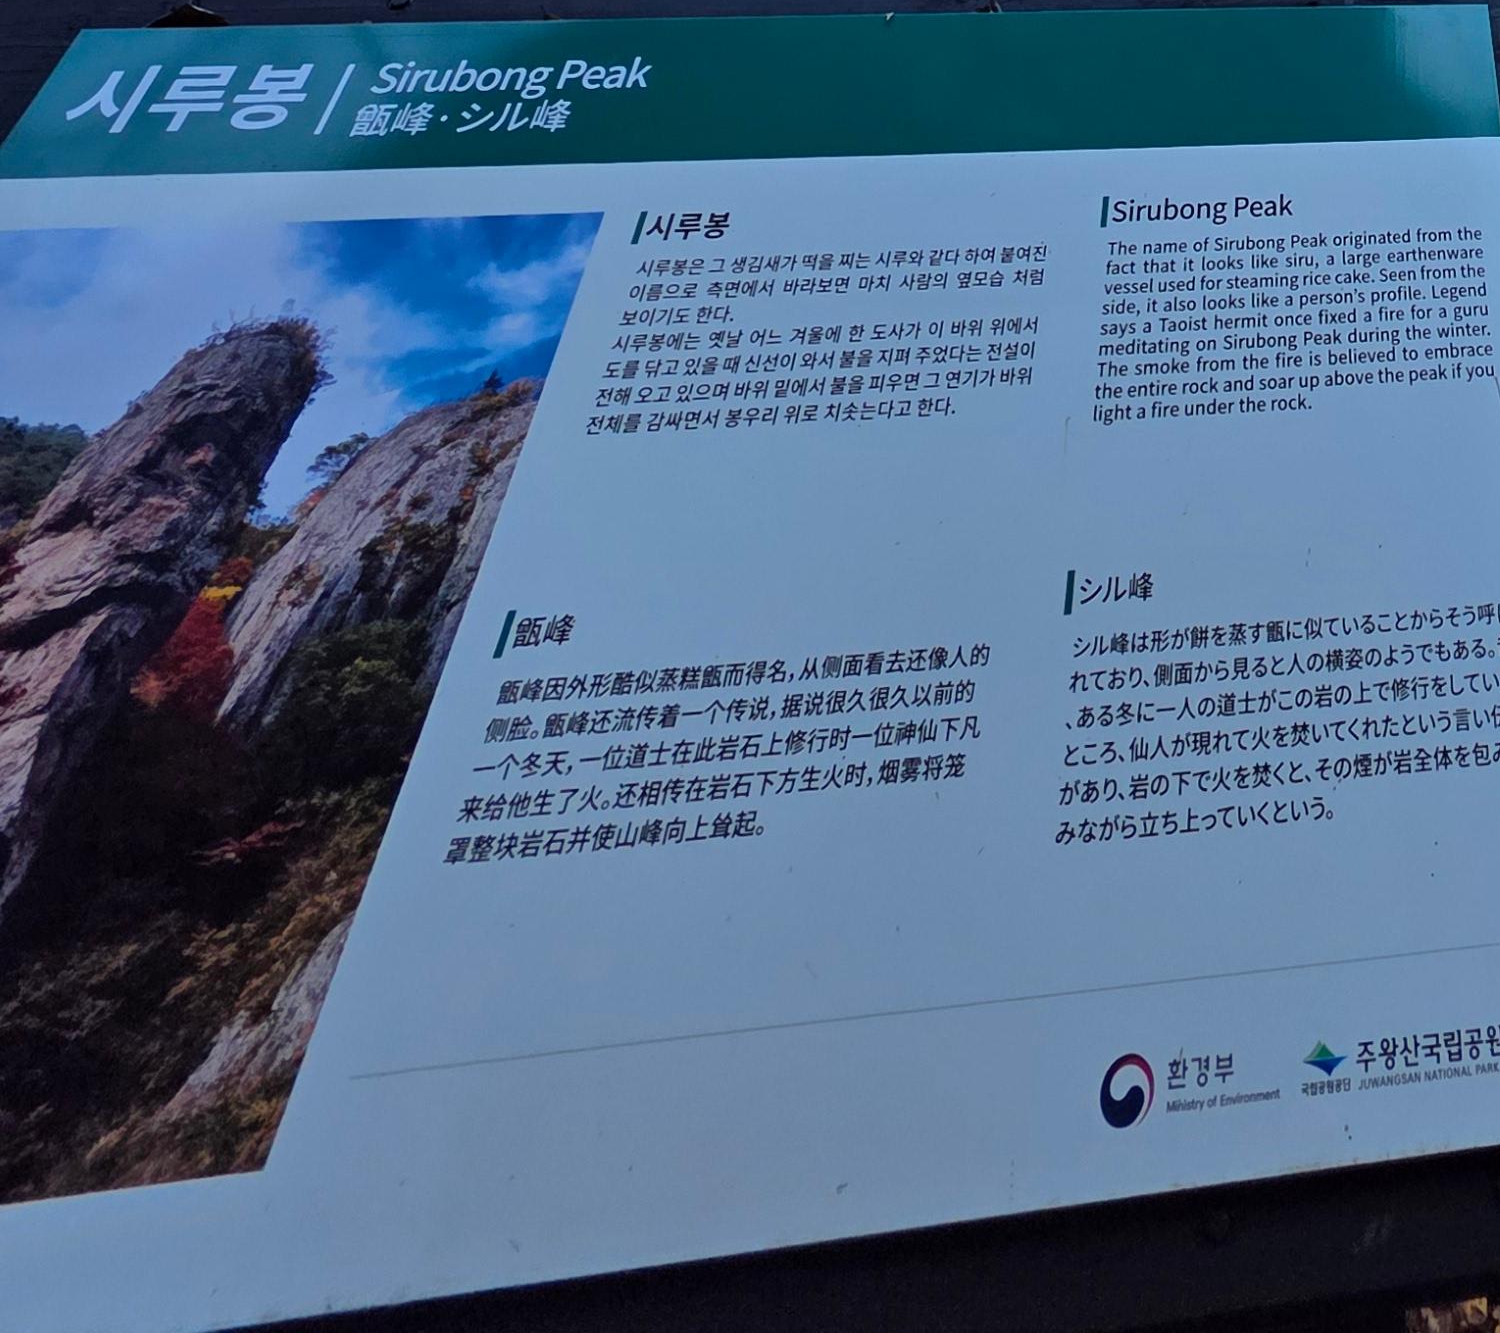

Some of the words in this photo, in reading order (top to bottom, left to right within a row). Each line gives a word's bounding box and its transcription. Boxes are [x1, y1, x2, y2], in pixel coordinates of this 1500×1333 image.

[370, 59, 554, 99] Sirubong
[556, 56, 652, 90] Peak
[65, 63, 314, 133] 시루봉
[646, 211, 731, 241] 시루봉
[1112, 197, 1228, 225] Sirubong
[1234, 193, 1292, 218] Peak
[1108, 241, 1137, 255] The
[1143, 242, 1187, 254] name
[1193, 237, 1210, 252] of
[1214, 235, 1285, 253] Sirubong
[1291, 233, 1327, 249] Peak
[1333, 229, 1410, 250] originated
[1416, 228, 1452, 242] from
[1458, 227, 1481, 241] the
[636, 259, 704, 277] 시루봉은
[708, 259, 725, 273] 그
[731, 255, 798, 274] 생김새가
[802, 254, 834, 271] 떡을
[838, 253, 870, 269] 찌는
[875, 250, 924, 268] 시루와
[929, 249, 960, 266] 같다
[965, 247, 996, 265] 하여
[1000, 242, 1047, 263] 붙여진
[1106, 260, 1136, 275] fact
[1144, 258, 1176, 273] that
[1184, 257, 1194, 272] it
[1202, 255, 1244, 271] looks
[1252, 254, 1278, 269] like
[1286, 252, 1319, 269] siru,
[1326, 255, 1334, 265] a
[1342, 250, 1380, 268] large
[1387, 247, 1483, 263] earthenware
[630, 283, 698, 302] 이름으로
[706, 279, 775, 299] 측면에서
[783, 276, 850, 296] 바라보면
[858, 274, 891, 292] 마치
[899, 271, 948, 291] 사람의
[957, 270, 1004, 289] 옆모습
[1012, 268, 1044, 286] 처럼
[1105, 277, 1153, 295] vessel
[1158, 276, 1195, 293] used
[1200, 275, 1223, 291] for
[1226, 272, 1299, 291] steaming
[1303, 271, 1331, 286] rice
[1335, 269, 1375, 284] cake.
[1379, 268, 1416, 282] Seen
[1420, 265, 1456, 280] from
[1460, 263, 1485, 278] the
[619, 307, 691, 327] 보이기도
[696, 305, 734, 324] 한다.
[1102, 299, 1140, 317] side,
[1147, 298, 1158, 313] it
[1164, 297, 1196, 312] also
[1203, 294, 1245, 311] looks
[1252, 292, 1279, 308] like
[1284, 295, 1293, 307] a
[1300, 288, 1365, 310] person’s
[1371, 285, 1426, 306] profile.
[1432, 282, 1486, 302] Legend
[612, 332, 701, 353] 시루봉에는
[708, 329, 744, 349] 옛날
[750, 329, 782, 347] 어느
[789, 325, 842, 345] 겨울에
[849, 325, 865, 343] 한
[870, 321, 922, 341] 도사가
[929, 321, 944, 339] 이
[950, 319, 983, 337] 바위
[990, 317, 1038, 336] 위에서
[1099, 337, 1190, 357] meditating
[1196, 339, 1216, 351] on
[1223, 332, 1298, 351] Sirubong
[1304, 329, 1342, 346] Peak
[1348, 327, 1400, 345] during
[1405, 325, 1431, 340] the
[1437, 322, 1490, 338] winter.
[602, 360, 640, 379] 도를
[645, 359, 679, 379] 닦고
[682, 357, 718, 376] 있을
[722, 355, 742, 374] 때
[745, 352, 797, 373] 신선이
[800, 350, 835, 370] 와서
[840, 349, 873, 369] 불을
[877, 347, 911, 367] 지펴
[915, 344, 982, 365] 주었다는
[986, 341, 1035, 361] 전설이
[1098, 361, 1128, 377] The
[1134, 357, 1190, 375] smoke
[1196, 356, 1235, 372] from
[1242, 353, 1269, 370] the
[1276, 352, 1302, 368] fire
[1309, 351, 1322, 366] is
[1328, 345, 1396, 365] believed
[1402, 347, 1418, 361] to
[1425, 342, 1492, 360] embrace
[596, 387, 632, 407] 전해
[634, 386, 672, 403] 오고
[675, 381, 730, 403] 있으며
[734, 379, 770, 400] 바위
[774, 377, 826, 398] 밑에서
[830, 375, 864, 395] 불을
[868, 372, 920, 393] 피우면
[923, 373, 940, 388] 그
[946, 368, 996, 389] 연기가
[1000, 367, 1032, 386] 바위
[1096, 383, 1123, 399] the
[1128, 380, 1177, 397] entire
[1182, 377, 1218, 394] rock
[1223, 375, 1254, 392] and
[1259, 377, 1295, 390] soar
[1299, 376, 1320, 391] up
[1324, 370, 1373, 387] above
[1378, 367, 1404, 383] the
[1409, 364, 1447, 385] peak
[1452, 362, 1462, 379] if
[1466, 365, 1494, 382] you
[586, 413, 642, 435] 전체를
[647, 409, 720, 431] 감싸면서
[725, 405, 779, 428] 봉우리
[784, 405, 818, 424] 위로
[824, 399, 911, 422] 치솟는다고
[918, 397, 955, 417] 한다.
[1079, 573, 1154, 605] シル峰
[511, 614, 575, 649] 甑峰
[1167, 1053, 1235, 1090] 환경부
[1301, 1078, 1351, 1096] 국립공원공단
[1358, 1072, 1421, 1091] JUWANGSAN
[1424, 1066, 1472, 1082] NATIONAL
[1475, 1062, 1500, 1076] PARK
[1166, 1096, 1205, 1113] Ministry
[1207, 1095, 1217, 1108] of
[1220, 1089, 1281, 1107] Environment
